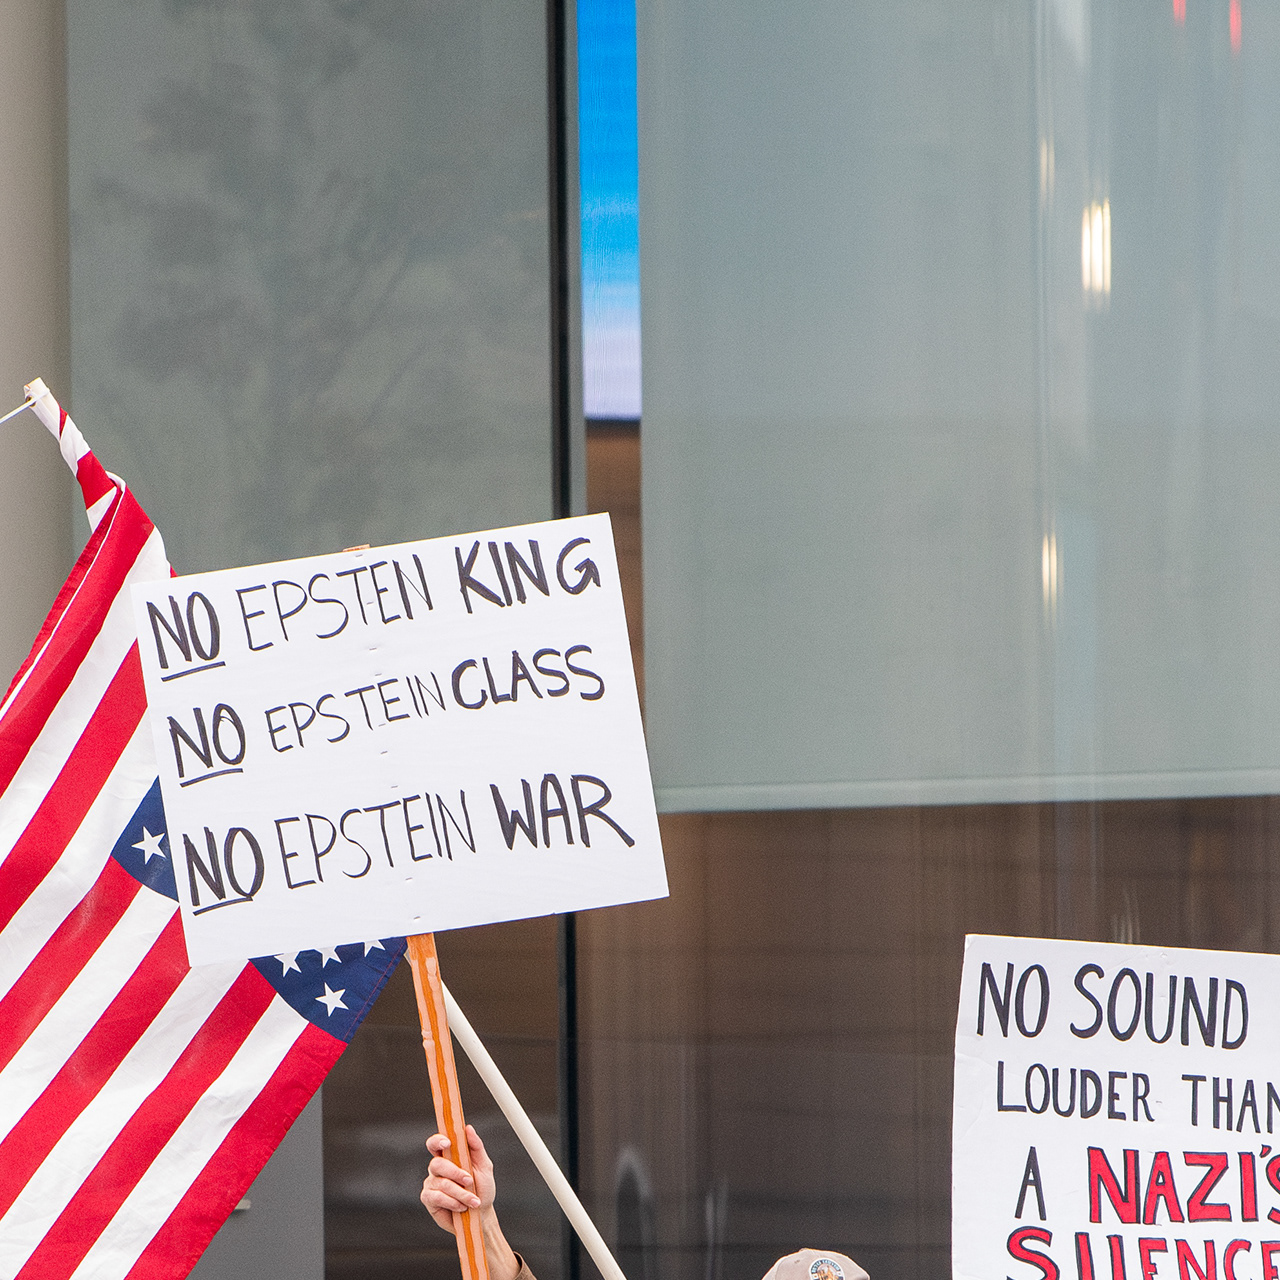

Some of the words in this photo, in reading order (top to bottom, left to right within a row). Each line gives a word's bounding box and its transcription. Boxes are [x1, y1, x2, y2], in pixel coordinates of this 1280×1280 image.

[147, 591, 220, 668] NO
[235, 553, 434, 651] EPSTEN
[455, 537, 601, 614] KING
[167, 703, 246, 778] NO
[265, 672, 446, 753] EPSTEIN
[451, 645, 605, 710] CLASS
[182, 826, 265, 907] NO
[274, 789, 476, 889] EPSTEIN
[489, 773, 635, 850] WAR
[976, 961, 1050, 1039] NO
[1069, 963, 1249, 1050] SOUND
[996, 1060, 1155, 1122] LOUDER
[1014, 1145, 1047, 1221] A
